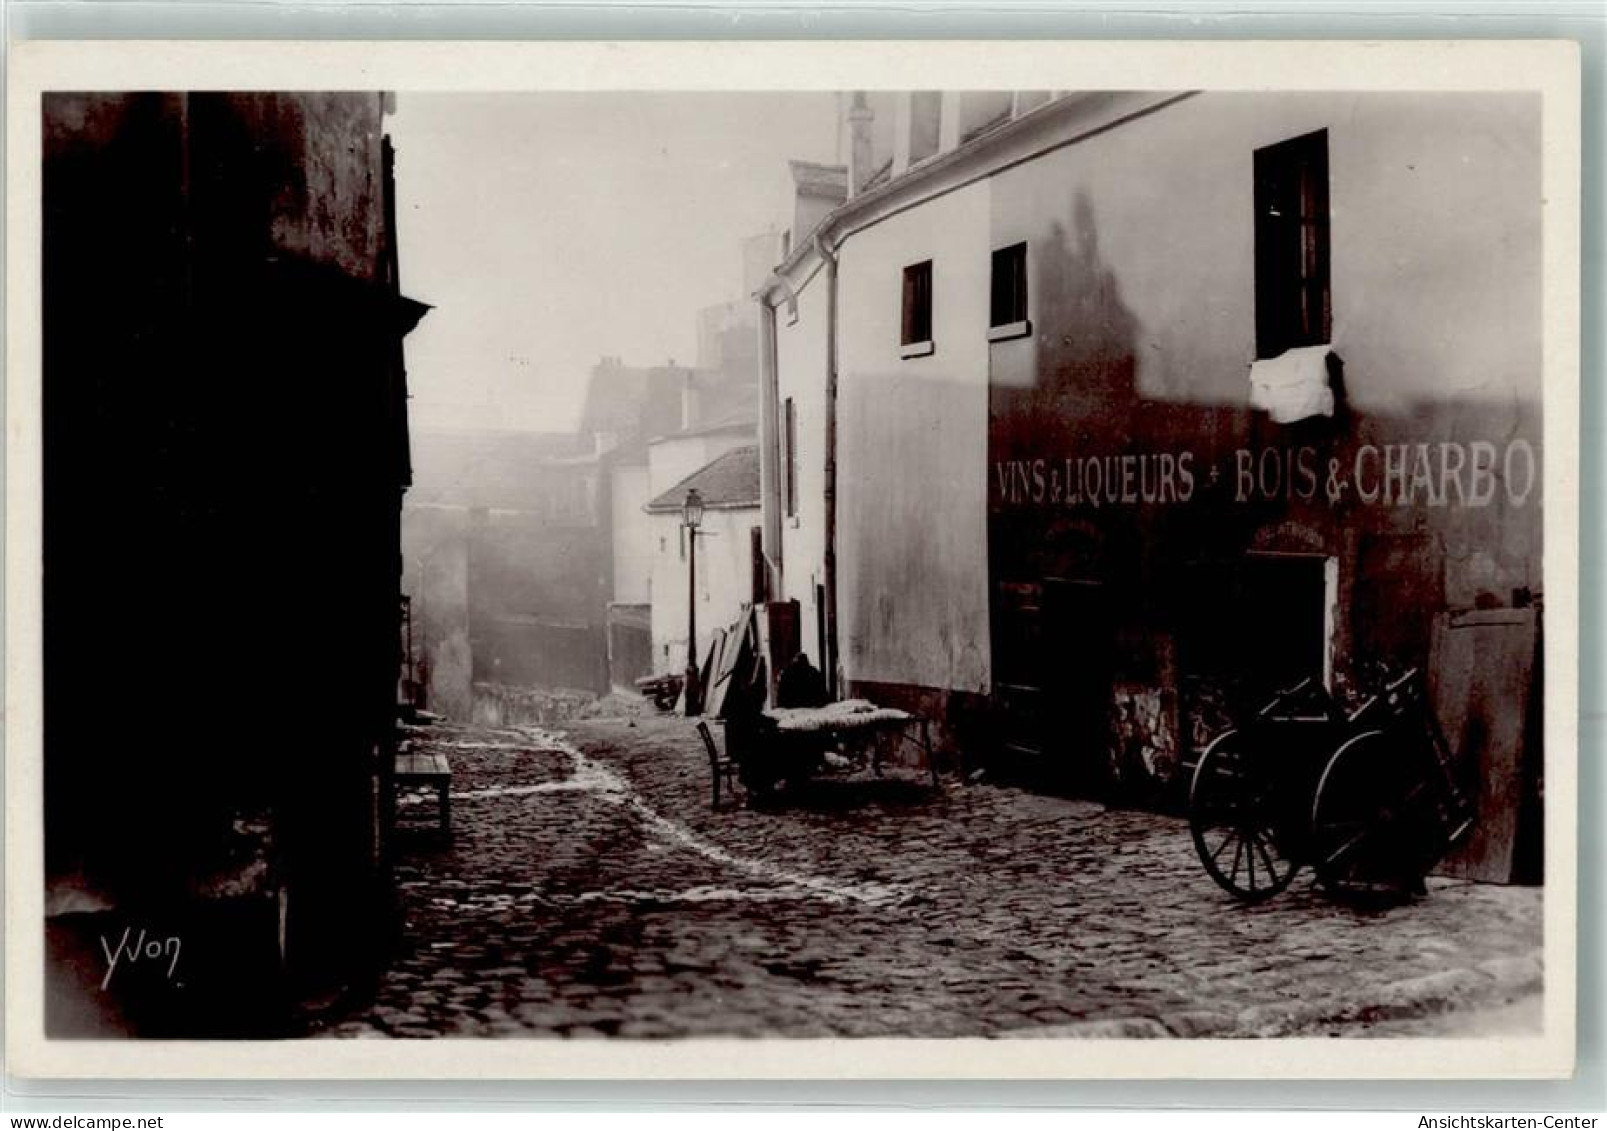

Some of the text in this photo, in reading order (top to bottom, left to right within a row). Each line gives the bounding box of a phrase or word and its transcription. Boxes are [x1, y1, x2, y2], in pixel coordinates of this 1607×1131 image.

[997, 459, 1046, 503] VINS
[1064, 450, 1195, 508] LIQUEURS
[1234, 438, 1543, 508] BOIS & CHARBO
